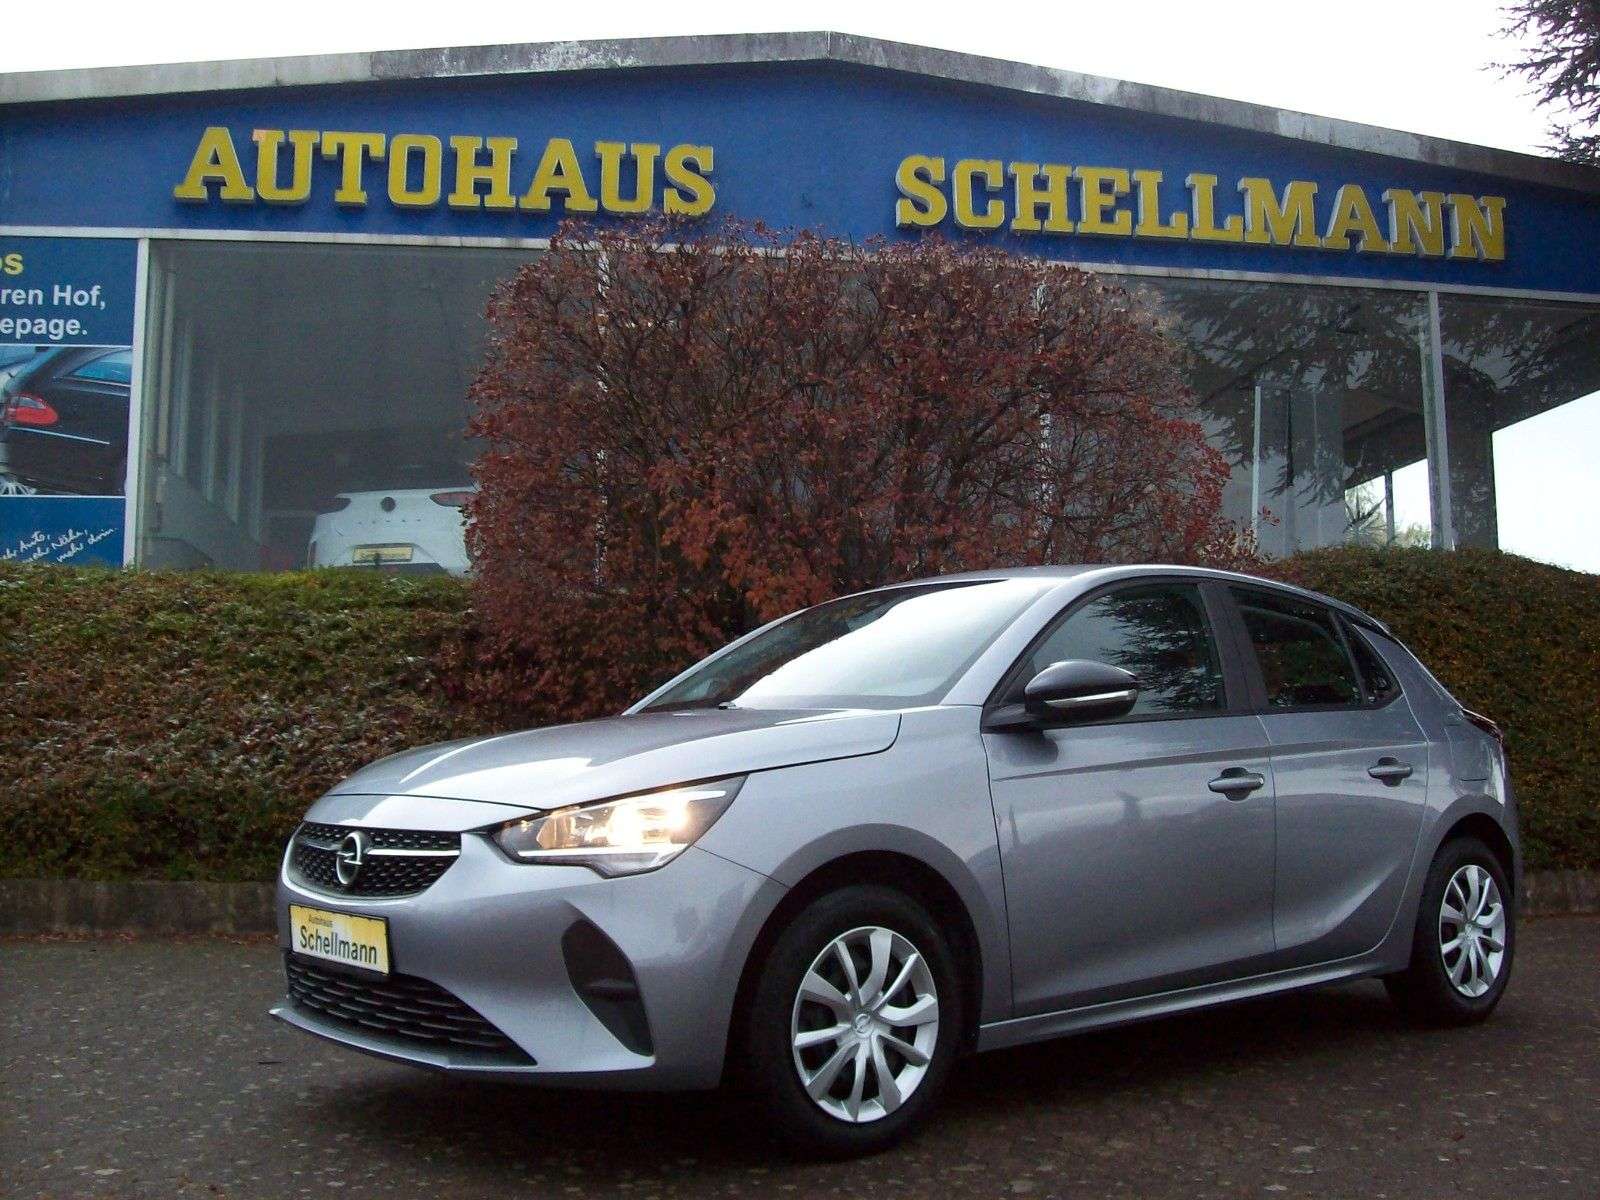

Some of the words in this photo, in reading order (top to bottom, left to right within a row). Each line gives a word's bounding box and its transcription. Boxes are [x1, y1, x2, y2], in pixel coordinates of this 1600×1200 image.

[173, 126, 718, 217] AUTOHAUS
[895, 154, 1507, 261] SCHELLMANN
[53, 284, 106, 311] Hof,
[0, 317, 88, 341] epage.
[299, 925, 377, 965] Schellmann
